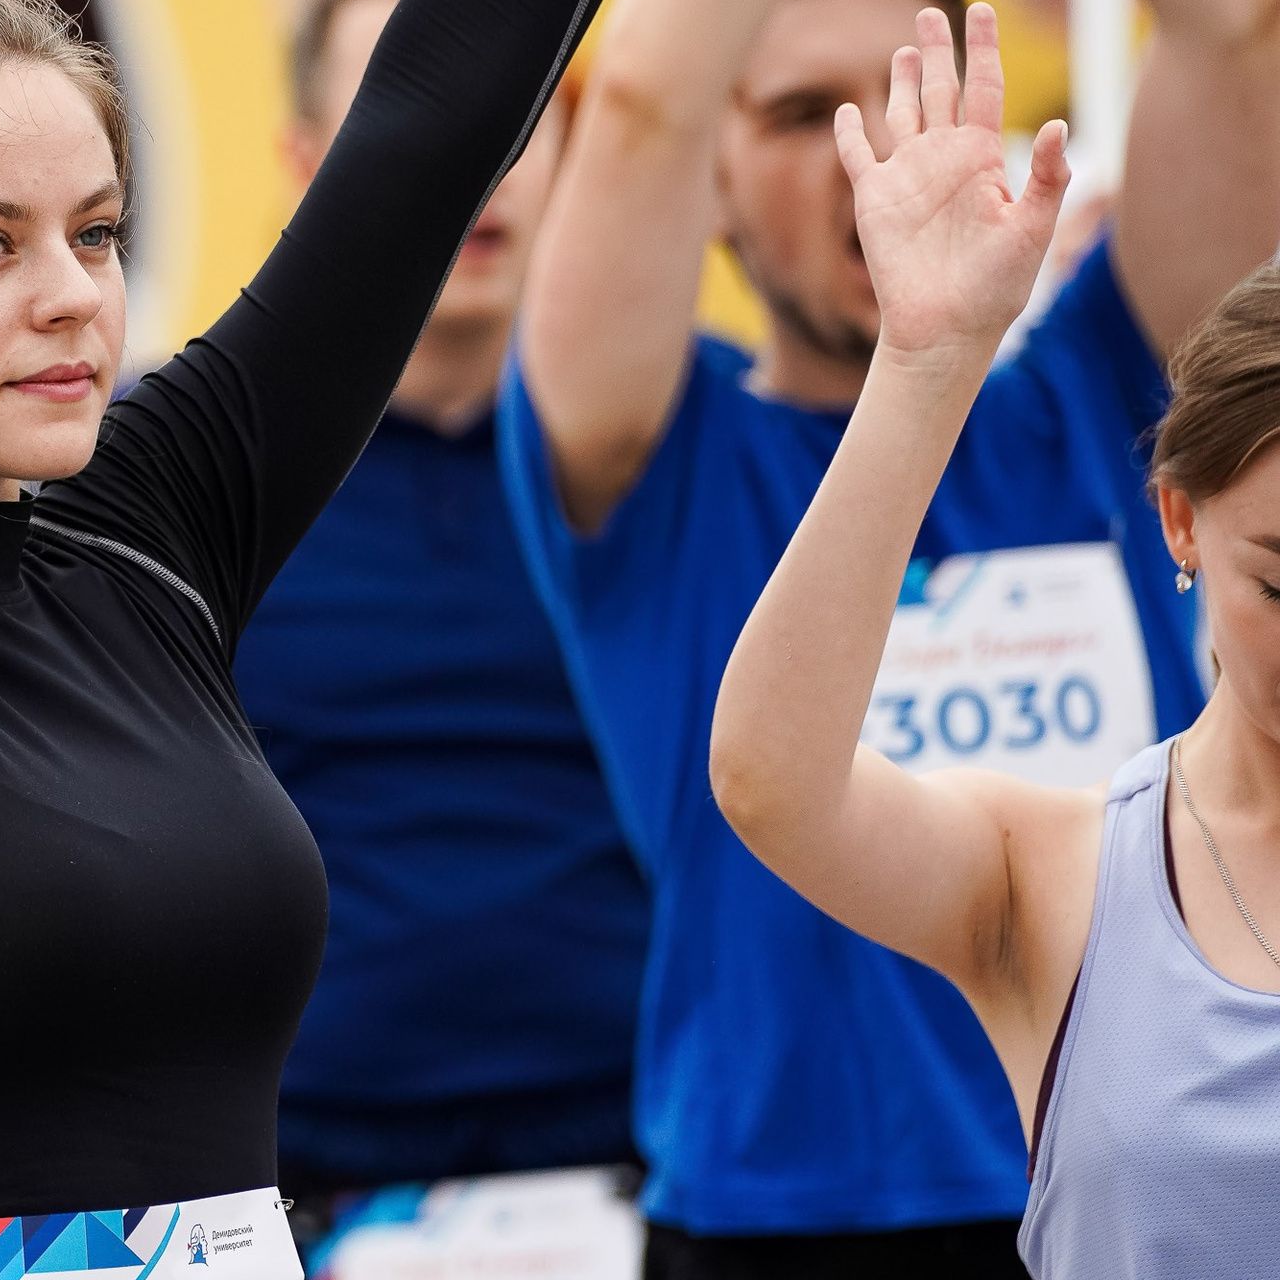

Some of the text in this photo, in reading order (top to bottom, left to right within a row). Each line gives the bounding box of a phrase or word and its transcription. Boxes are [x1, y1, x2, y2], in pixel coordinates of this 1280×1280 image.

[875, 675, 1100, 762] 3030
[212, 1224, 254, 1241] Демидовский
[213, 1239, 253, 1255] университет
